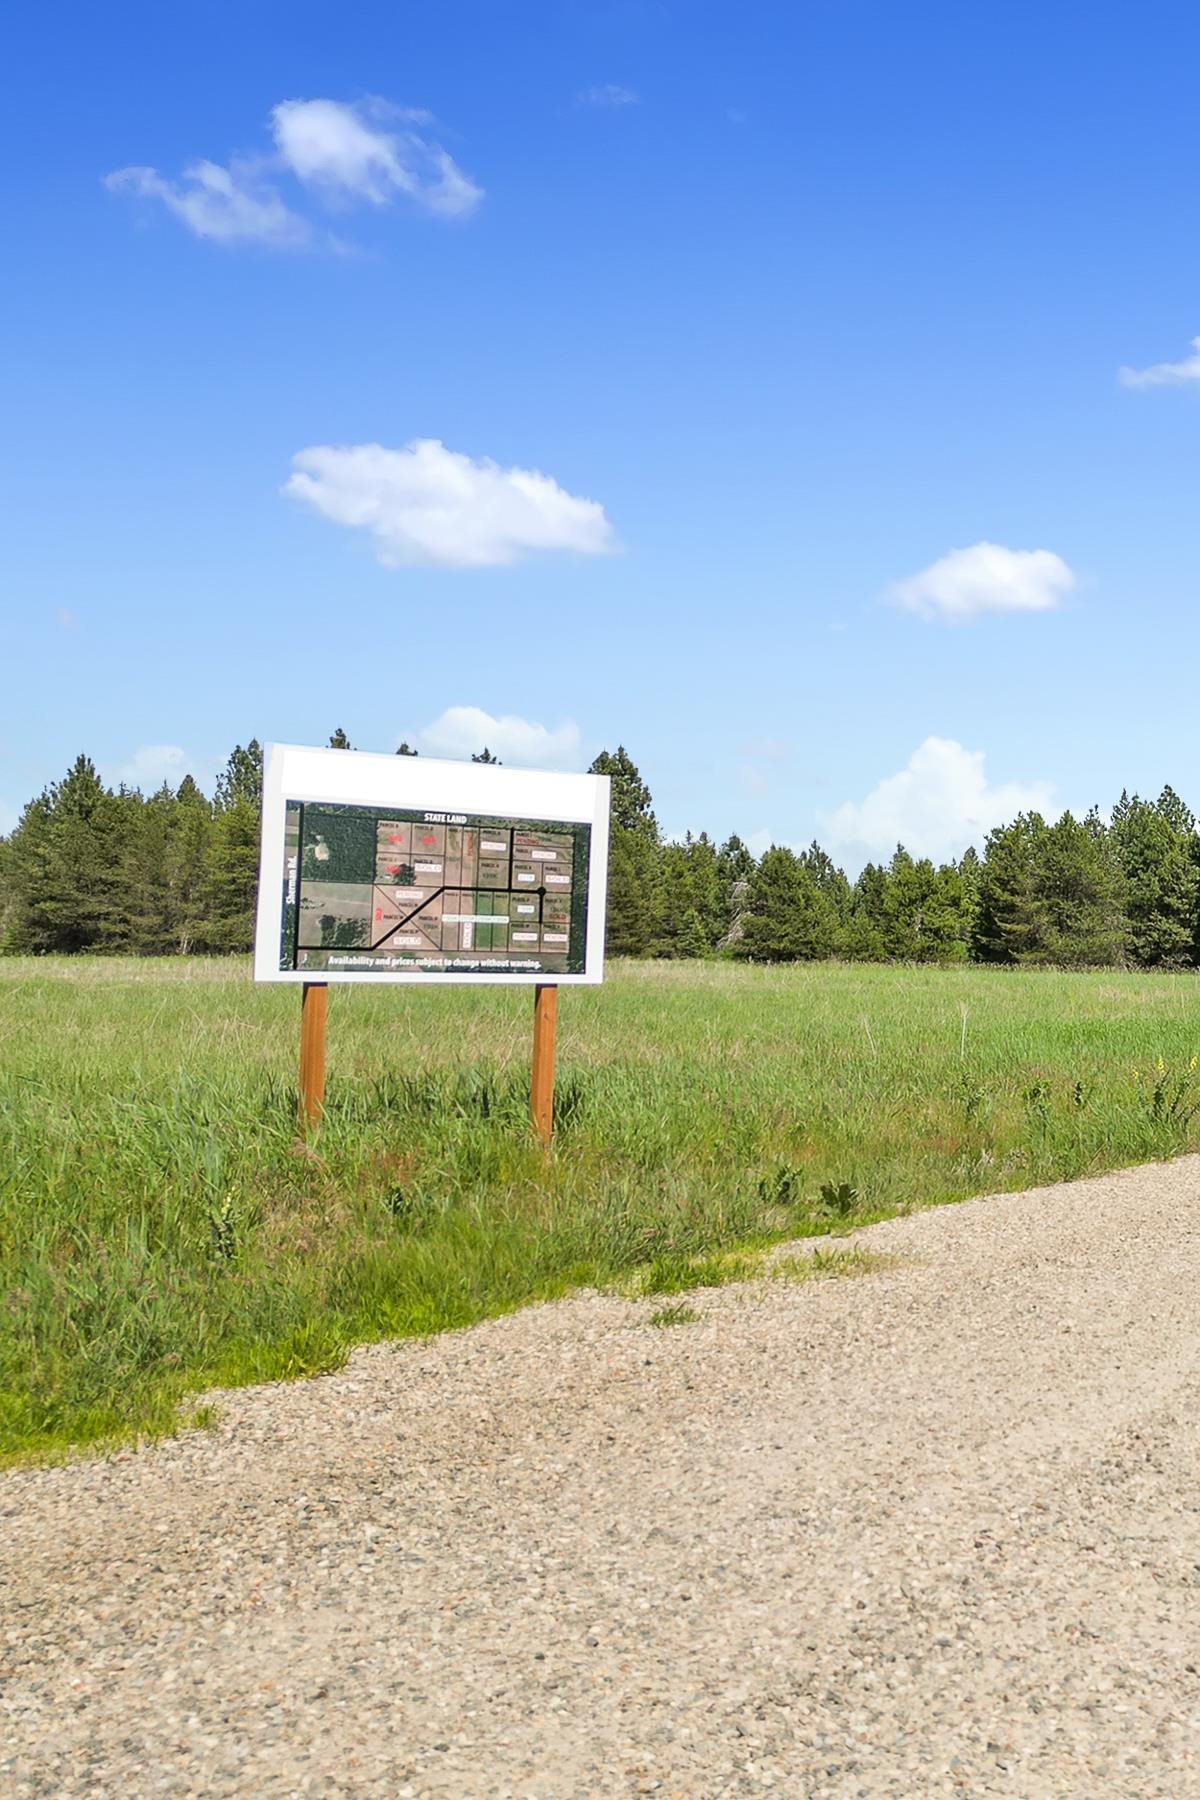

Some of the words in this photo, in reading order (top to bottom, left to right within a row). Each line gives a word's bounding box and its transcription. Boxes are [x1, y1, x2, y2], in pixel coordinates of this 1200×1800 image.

[424, 813, 446, 822] STATE
[447, 815, 467, 824] LAND
[286, 869, 296, 904] Sherman
[328, 955, 374, 967] Availability
[375, 957, 390, 965] and
[391, 957, 415, 968] prices
[415, 957, 443, 967] subject
[453, 959, 479, 968] change
[480, 959, 509, 967] without
[510, 959, 541, 969] warning.
